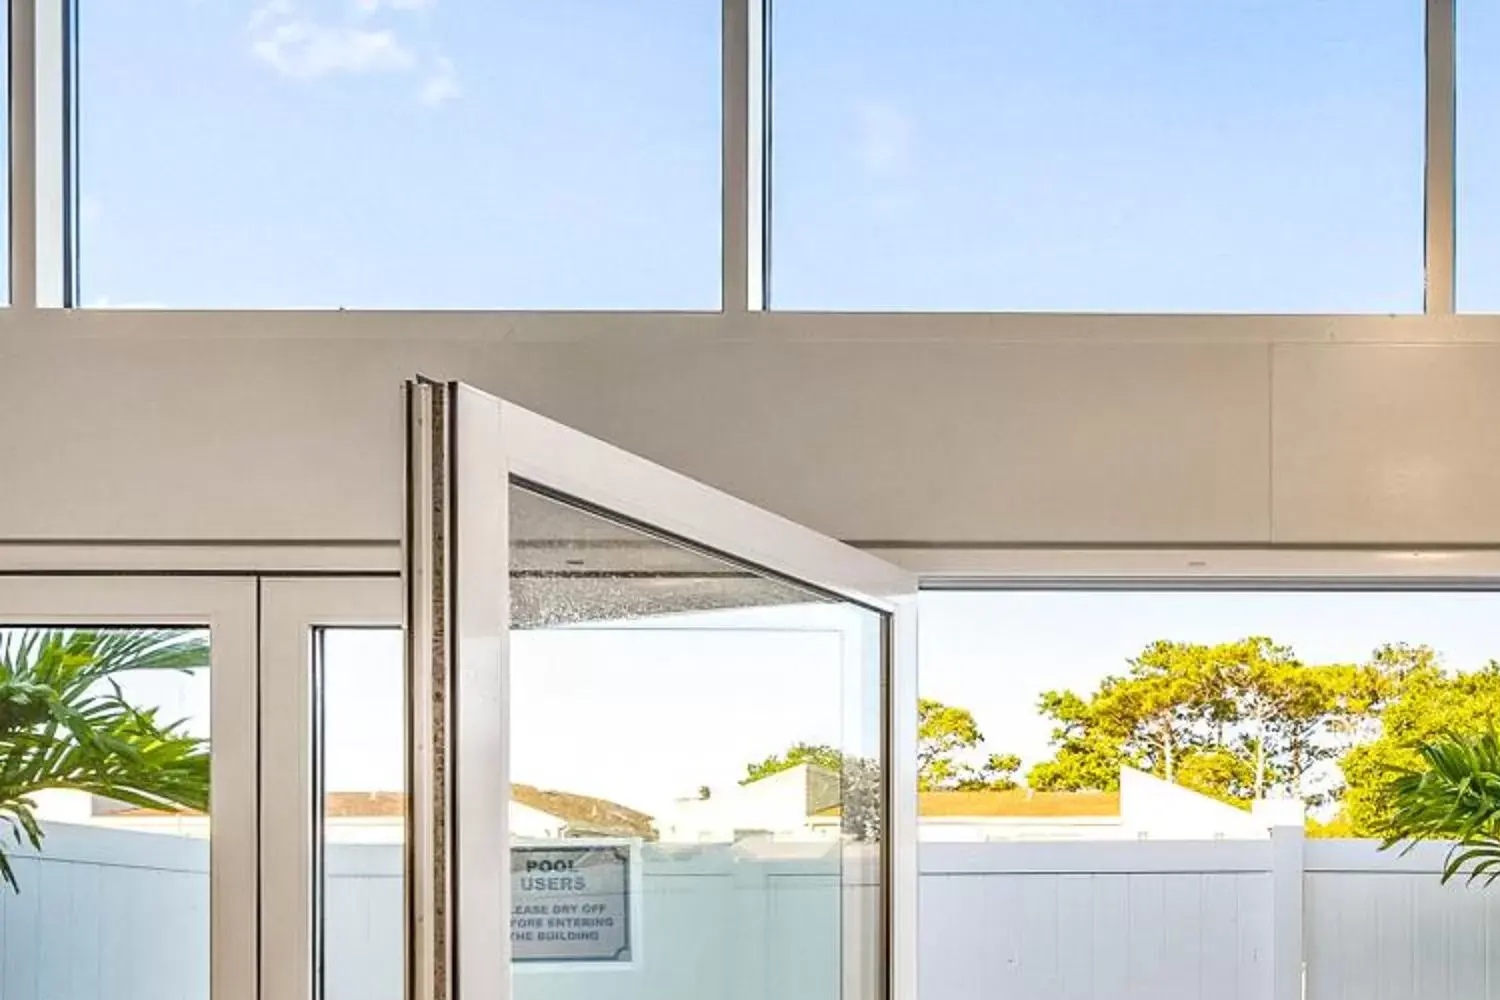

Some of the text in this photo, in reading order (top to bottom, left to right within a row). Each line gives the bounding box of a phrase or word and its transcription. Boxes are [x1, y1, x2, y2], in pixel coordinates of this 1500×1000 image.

[526, 859, 578, 873] POOL
[520, 877, 586, 891] USERS
[553, 904, 577, 915] DRY
[582, 904, 607, 915] OFF
[548, 917, 614, 928] ENTERING
[538, 931, 599, 941] BUILDING
